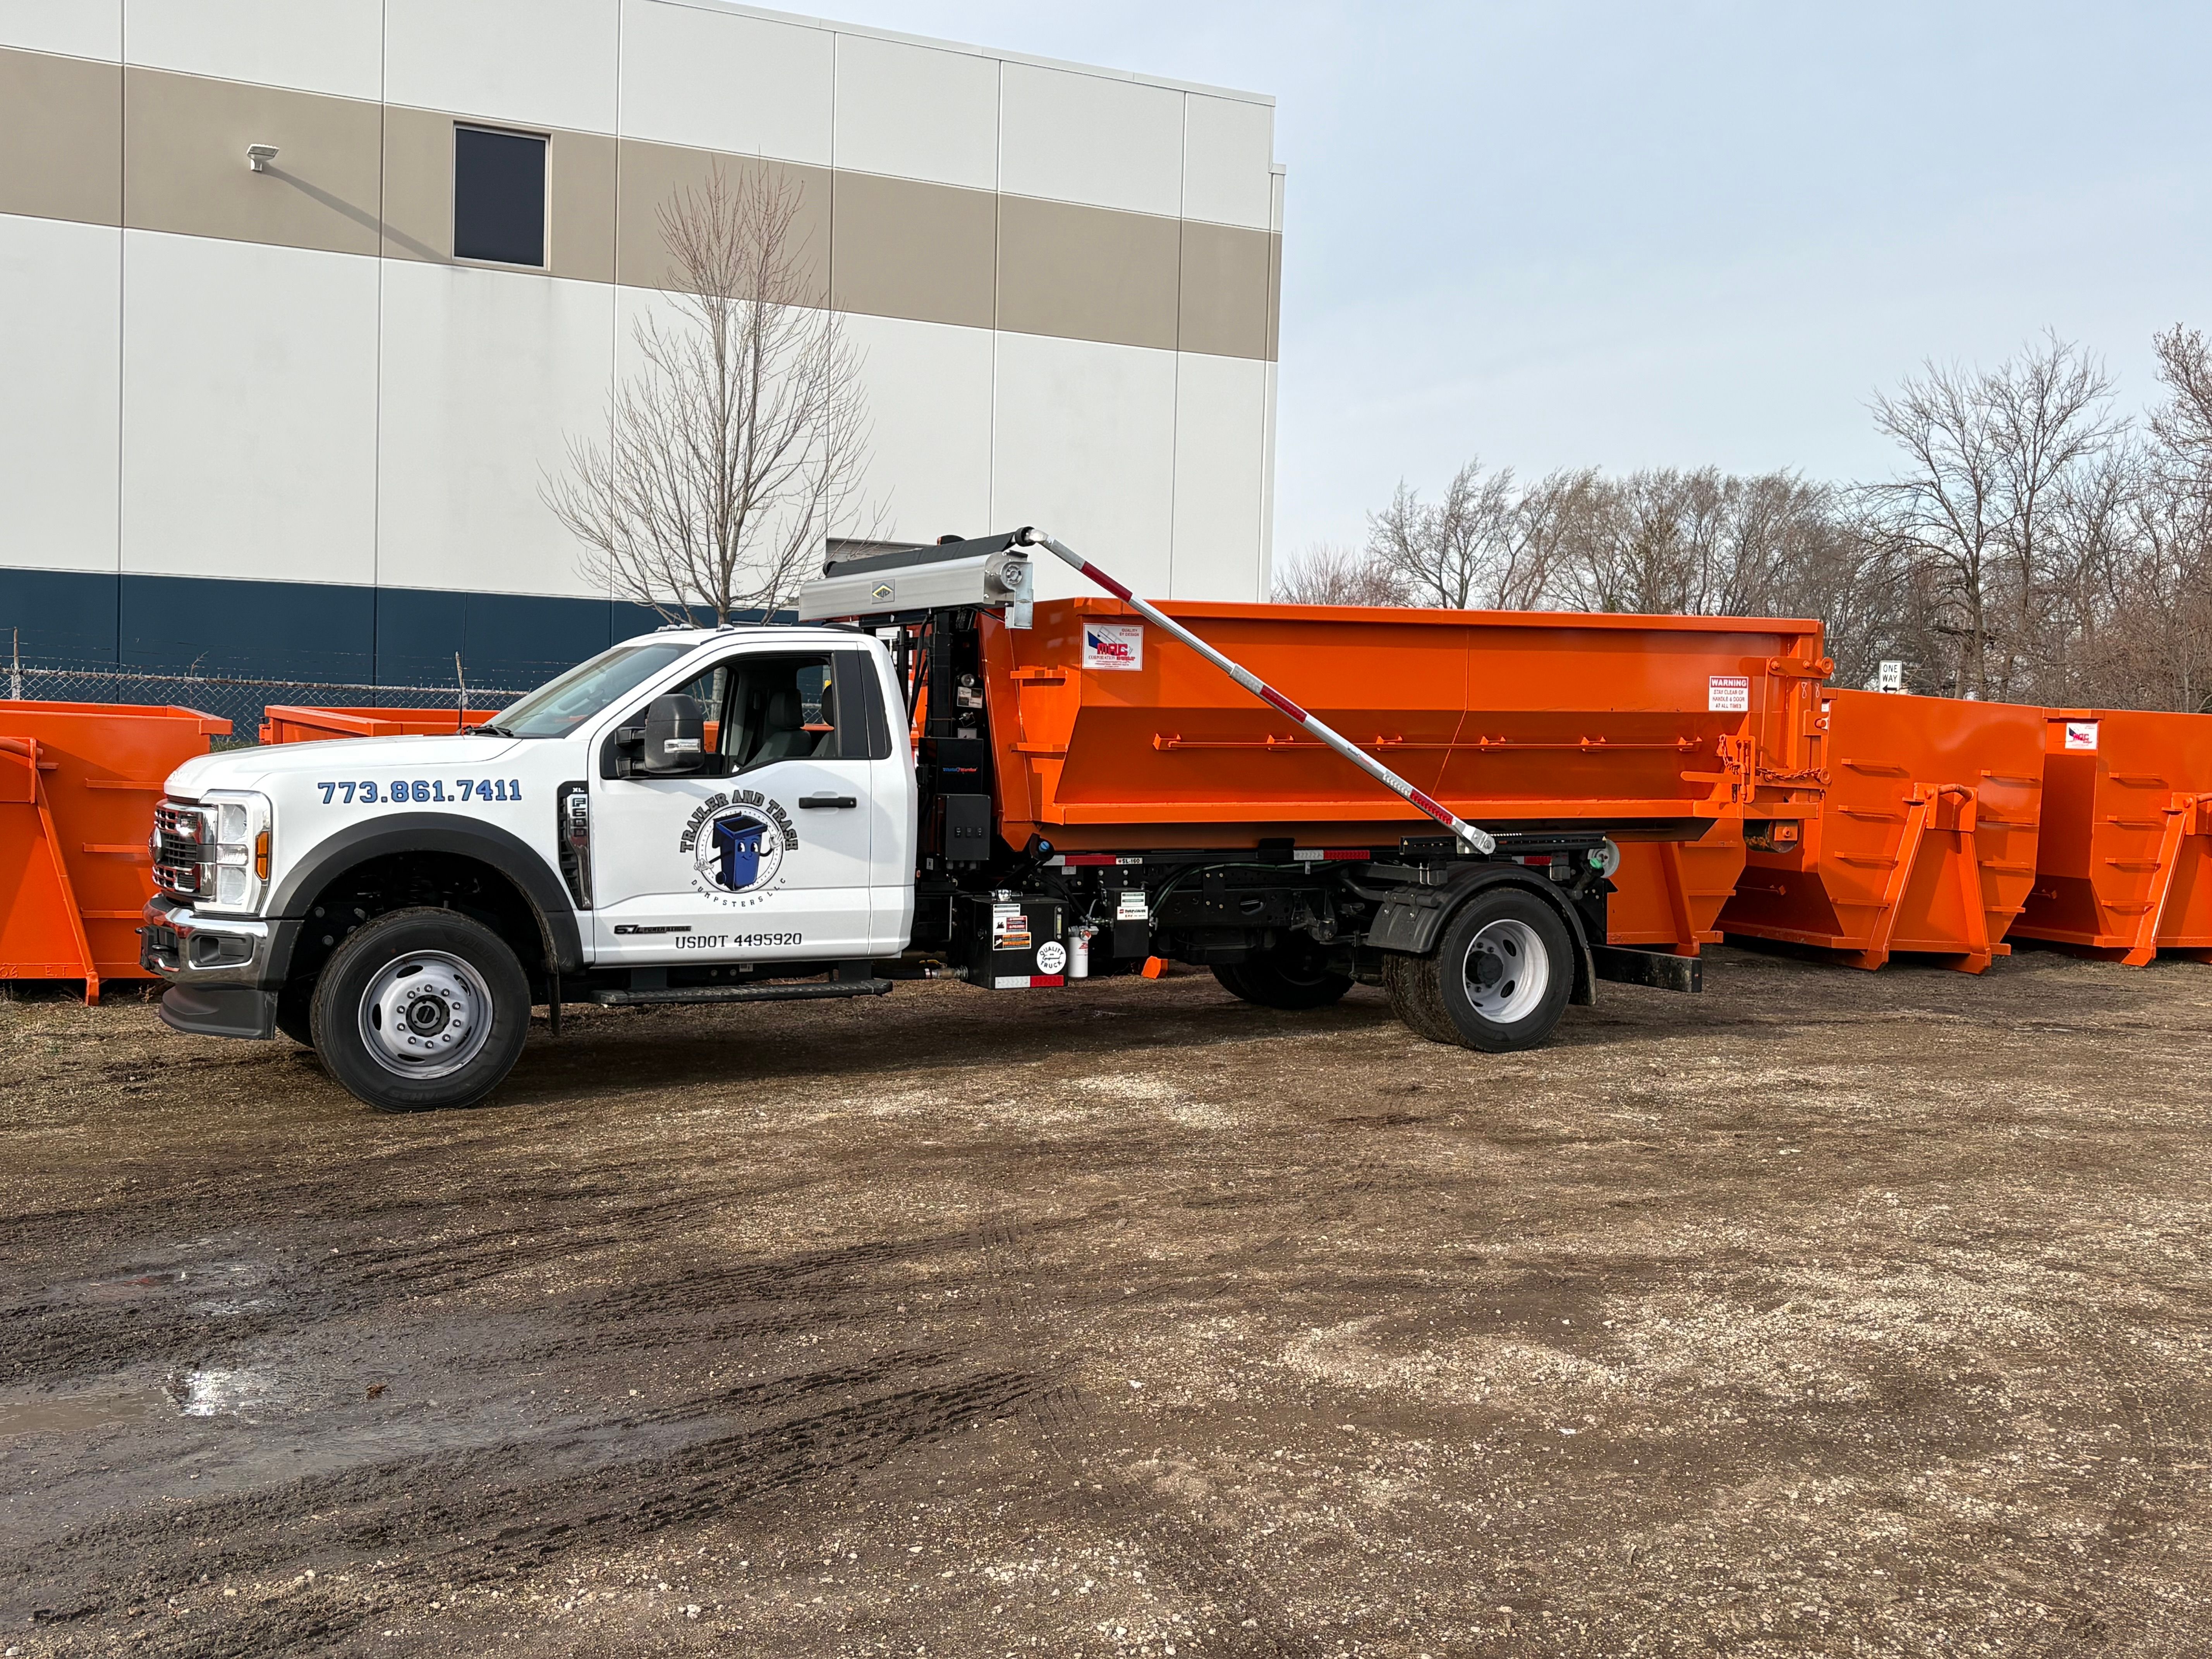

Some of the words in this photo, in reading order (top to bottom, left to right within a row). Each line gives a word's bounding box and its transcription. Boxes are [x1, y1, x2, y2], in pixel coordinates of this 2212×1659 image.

[1097, 643, 1128, 656] MAC
[1883, 664, 1898, 673] ONE
[1712, 678, 1747, 687] WARNING
[1883, 674, 1898, 682] WAY
[318, 780, 522, 804] 773.861.7411
[680, 793, 729, 853] TRAILER
[732, 790, 765, 807] AND
[766, 799, 799, 851] TRASH
[691, 879, 763, 907] DUMPSTERS
[675, 935, 728, 949] USDOT
[734, 933, 802, 946] 4495920
[1039, 946, 1064, 956] QUALITY
[1041, 960, 1062, 969] TRUCK
